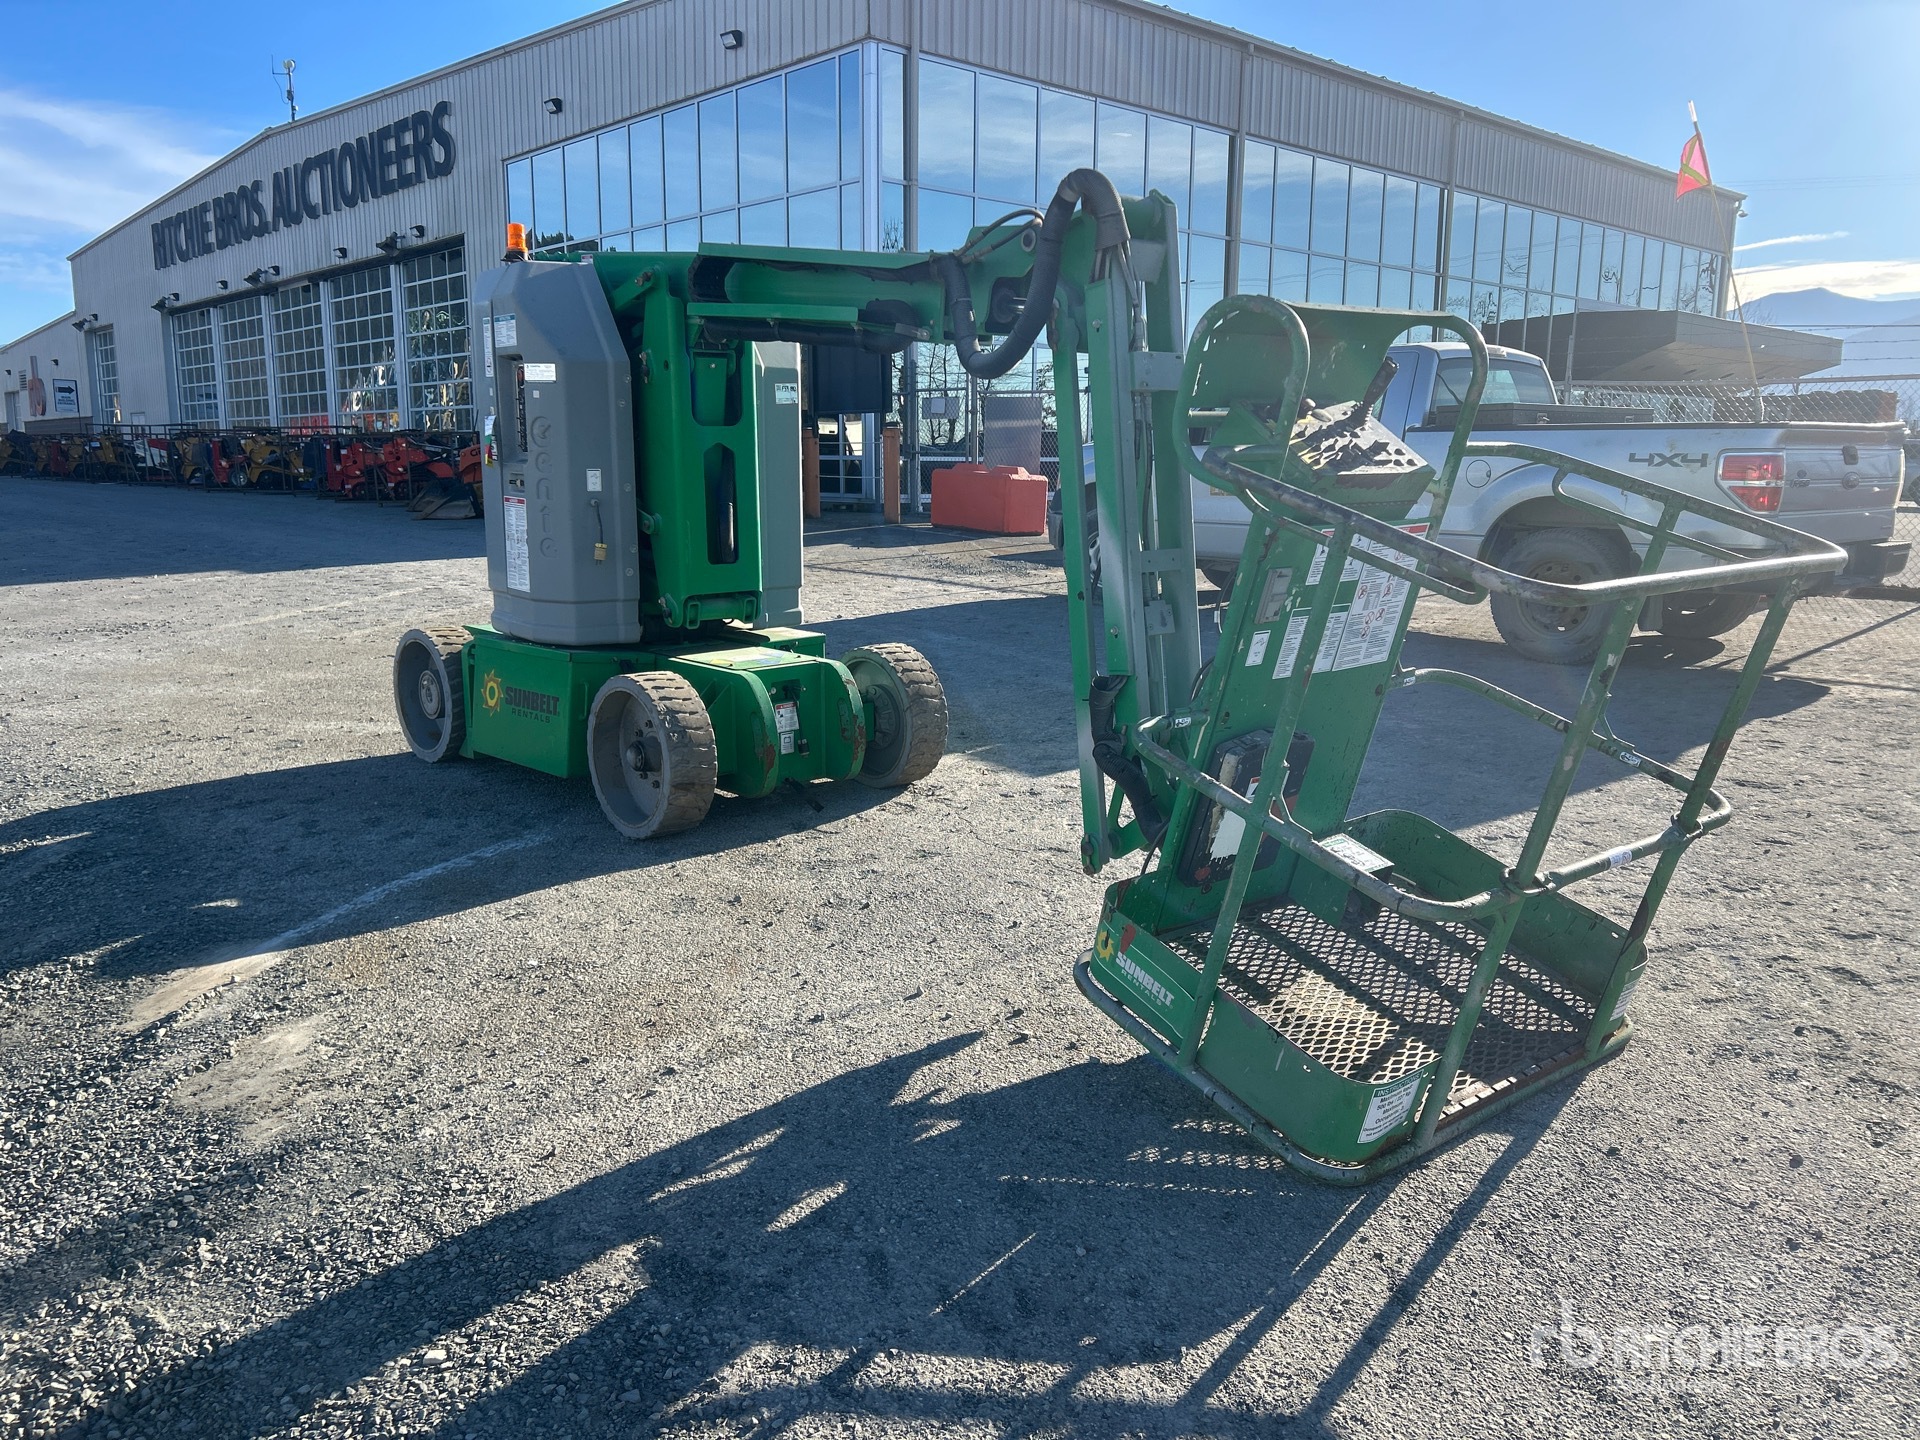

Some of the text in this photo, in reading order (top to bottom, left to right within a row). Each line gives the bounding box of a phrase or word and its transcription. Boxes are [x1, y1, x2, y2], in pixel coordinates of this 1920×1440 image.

[151, 201, 215, 270] RITCHIE
[272, 100, 456, 231] AUCTIONEERS
[1628, 452, 1709, 468] 4X4
[505, 686, 560, 716] SUNBELT
[511, 707, 551, 724] RENTALS
[1115, 951, 1175, 1007] SUNBELT
[1121, 969, 1162, 1006] RENTALS
